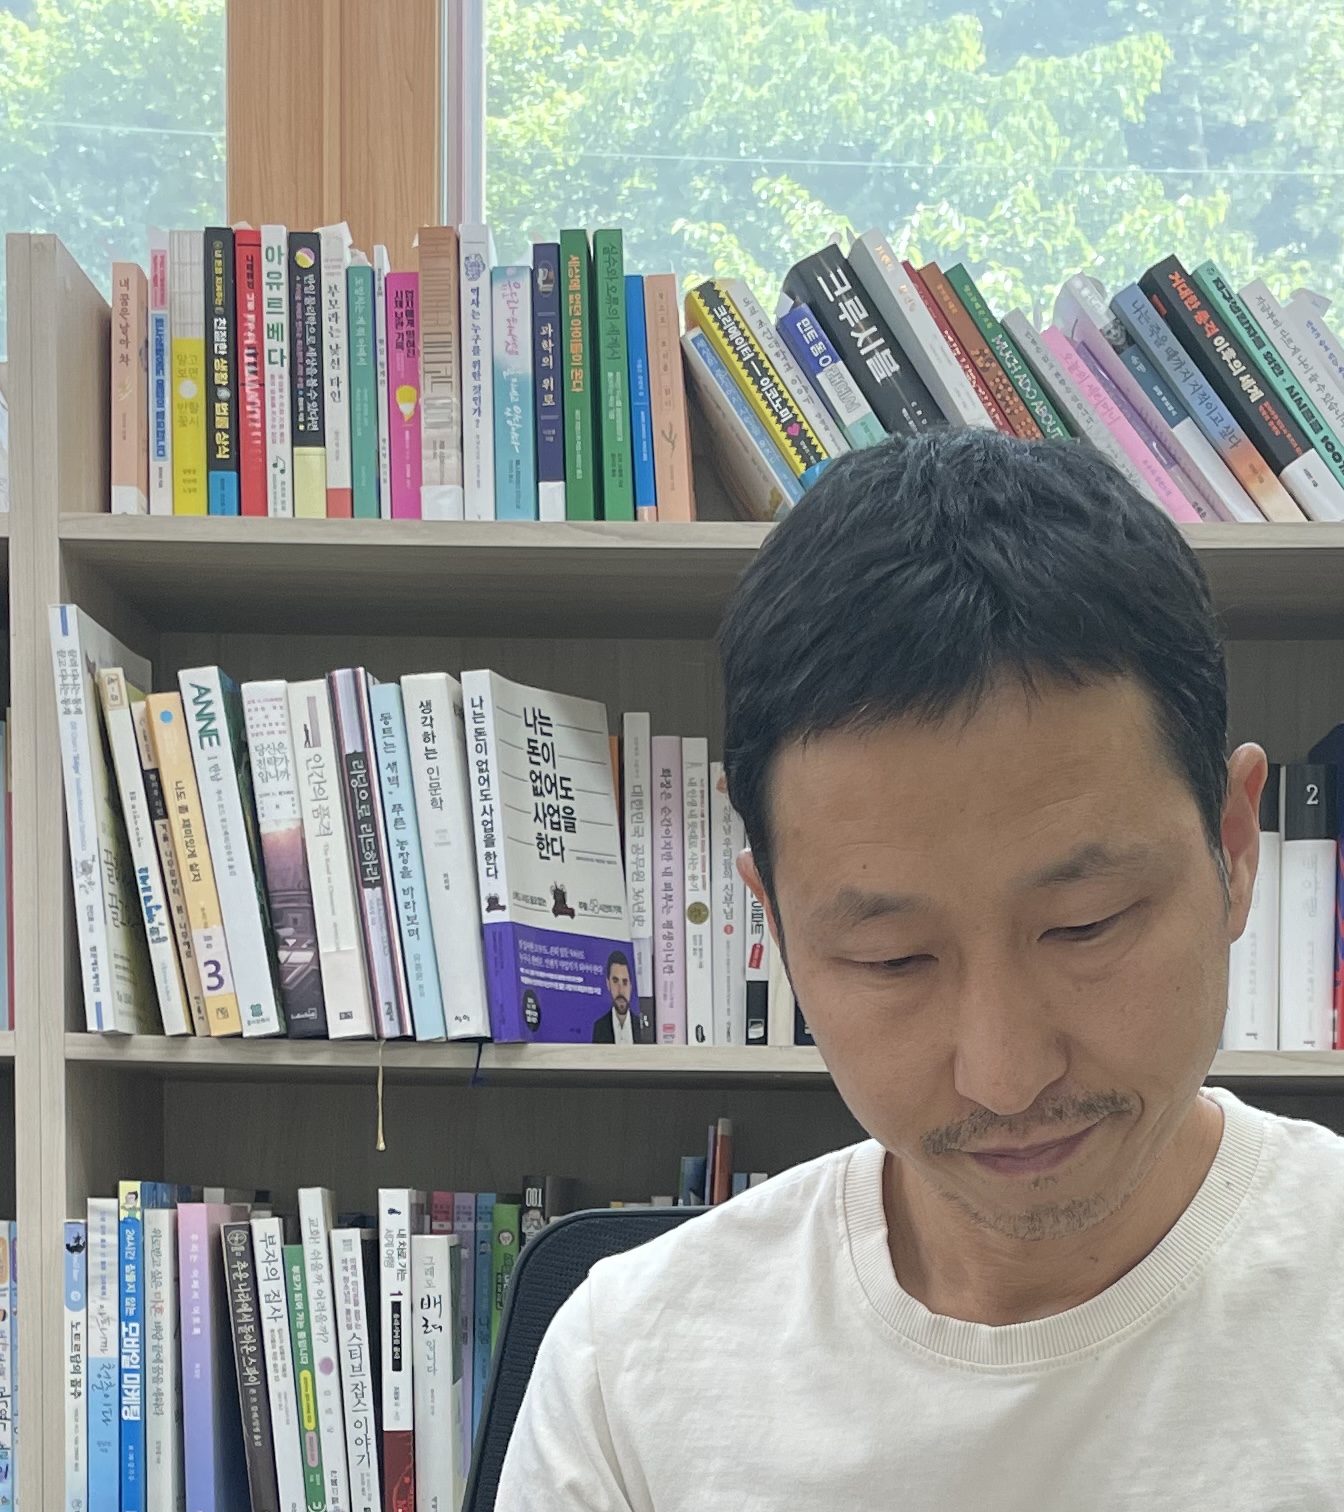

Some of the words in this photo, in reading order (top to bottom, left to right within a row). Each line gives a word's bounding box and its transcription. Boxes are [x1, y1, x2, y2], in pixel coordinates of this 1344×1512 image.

[539, 323, 554, 369] 과학의
[816, 266, 901, 384] 크루시블
[1132, 299, 1151, 325] 나는
[1147, 325, 1168, 347] 죽을
[1165, 345, 1194, 384] 때까지
[1168, 271, 1201, 311] 거대한
[1213, 336, 1247, 376] 이후의
[1239, 374, 1265, 404] 세계
[760, 378, 794, 423] 이코노미
[189, 684, 221, 749] ANNE
[418, 699, 439, 761] 생각하는
[522, 707, 554, 736] 나는
[525, 738, 558, 769] 돈이
[348, 757, 372, 819] 리딩으로
[428, 764, 444, 811] 인문학
[530, 769, 575, 804] 없어도
[1306, 784, 1320, 805] 2
[534, 799, 578, 835] 사업을
[356, 822, 380, 884] 리드하라
[535, 834, 566, 862] 한다
[260, 1231, 279, 1281] 부자의
[265, 1287, 282, 1322] 집사
[121, 1321, 141, 1369] 모바일
[121, 1373, 141, 1421] 마케팅
